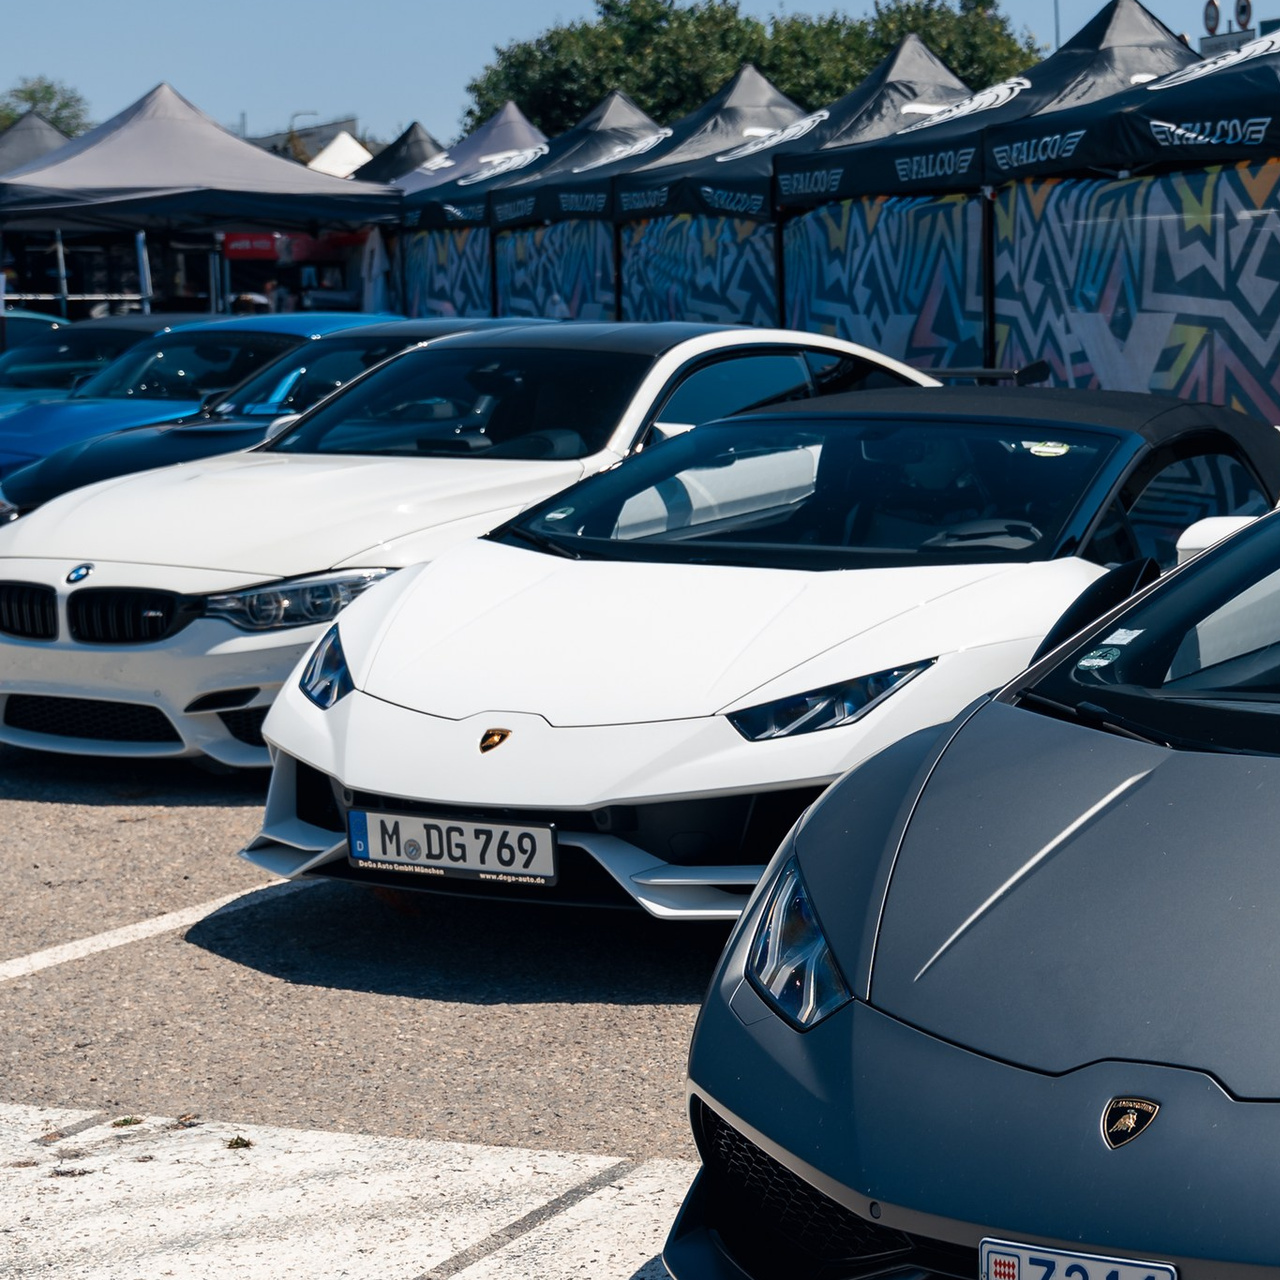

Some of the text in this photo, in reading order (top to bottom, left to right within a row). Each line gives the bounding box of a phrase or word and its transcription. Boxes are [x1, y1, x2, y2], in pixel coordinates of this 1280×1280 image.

[1173, 119, 1242, 145] FALCO
[1011, 135, 1060, 166] FALCO
[911, 151, 958, 180] FALCO
[357, 840, 364, 851] D
[380, 819, 401, 857] M
[378, 862, 393, 870] Auto
[394, 863, 414, 872] GmbH
